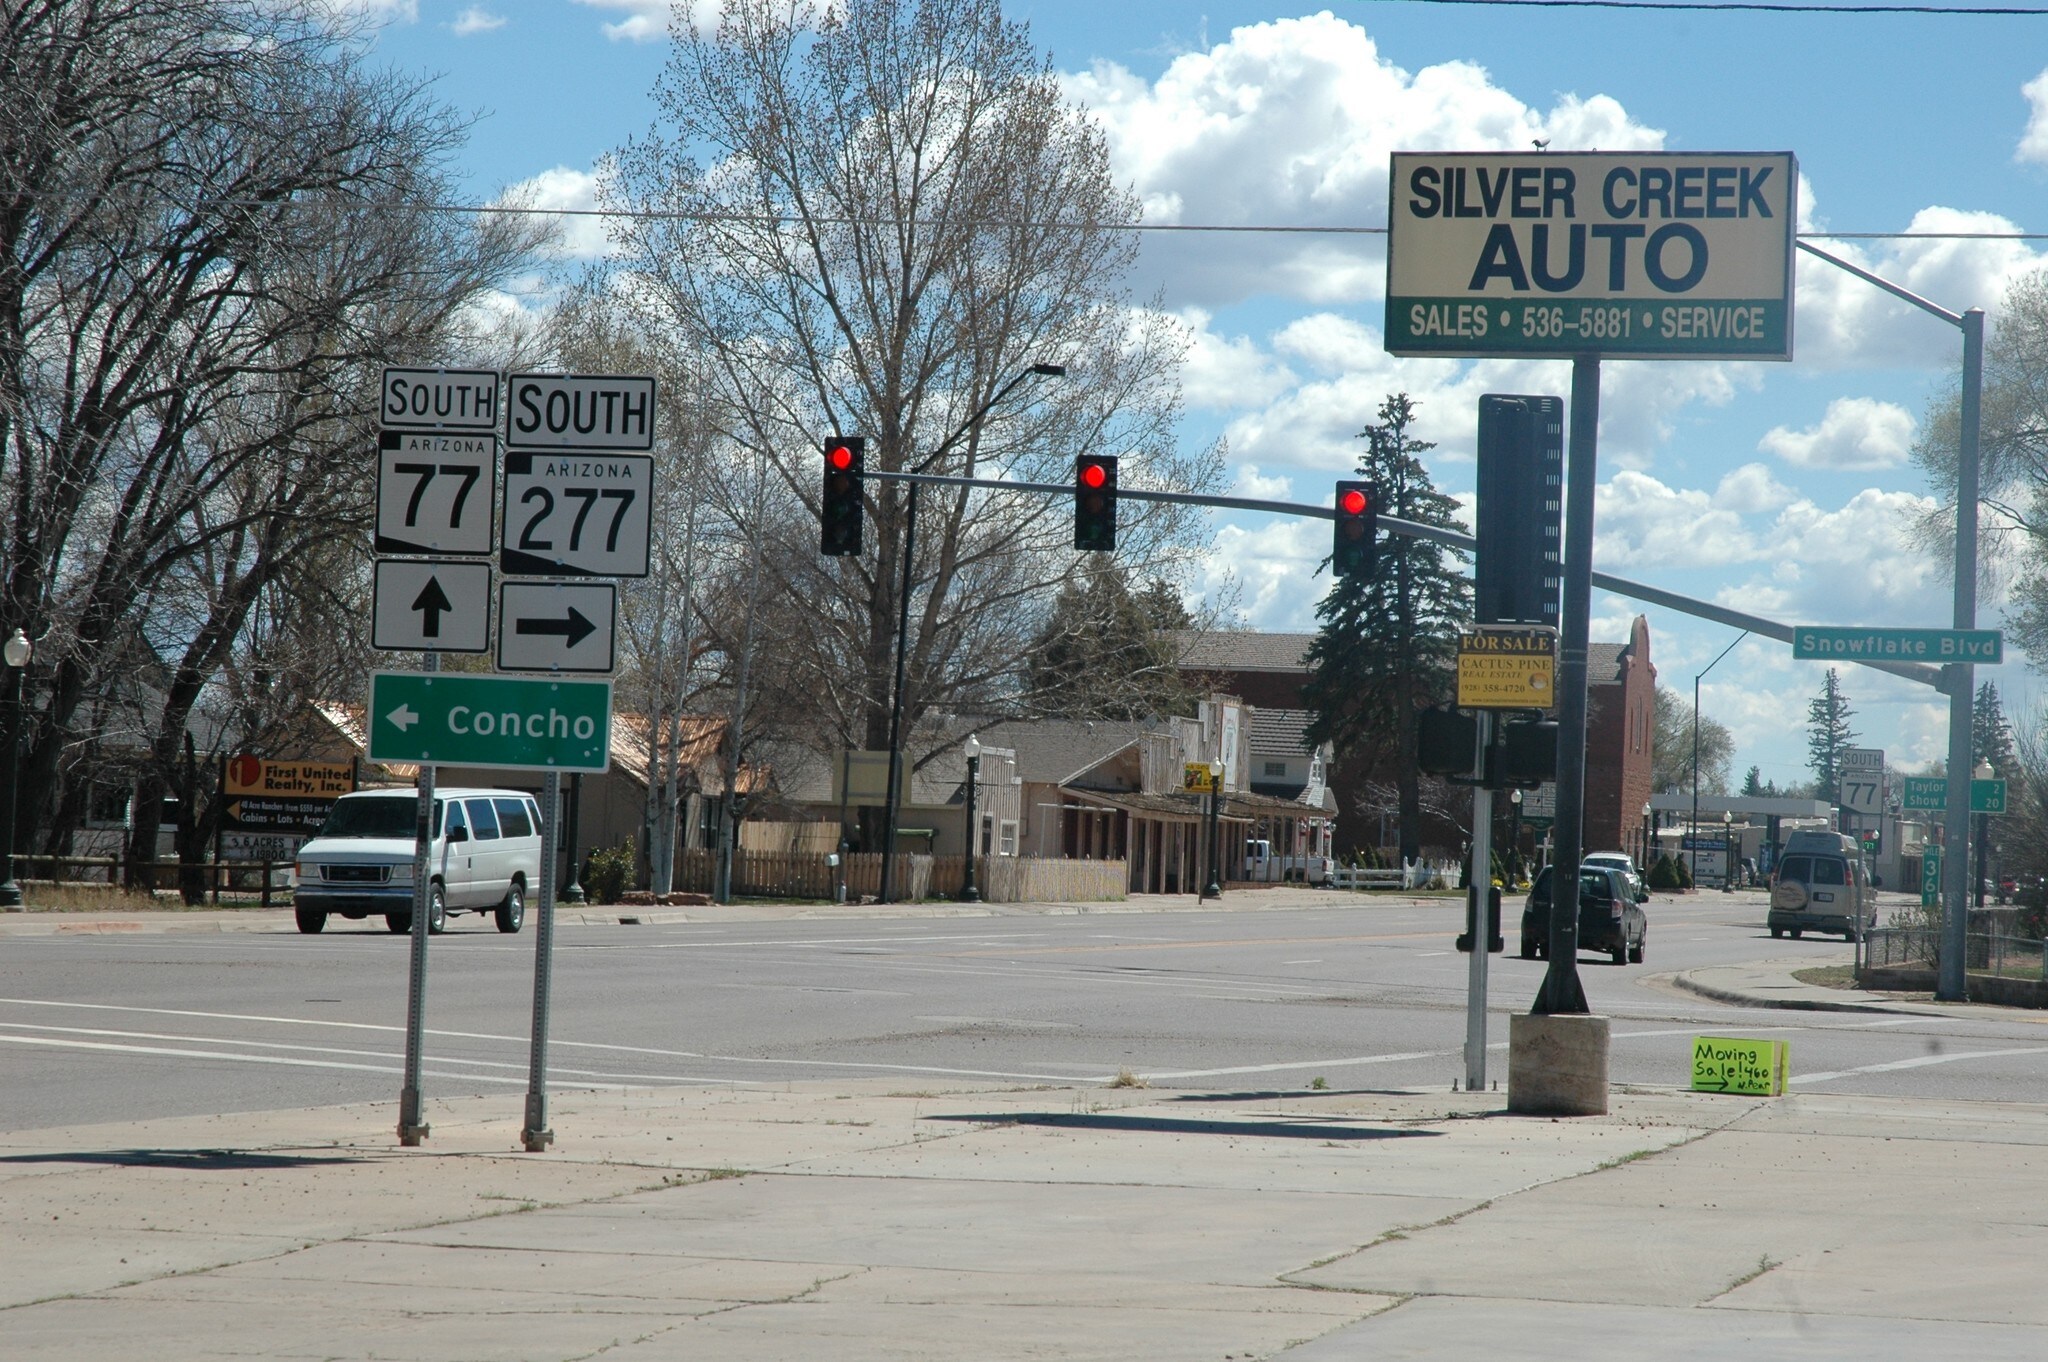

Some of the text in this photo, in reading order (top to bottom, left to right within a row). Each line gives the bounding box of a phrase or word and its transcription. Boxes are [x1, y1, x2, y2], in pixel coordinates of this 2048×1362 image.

[1409, 165, 1774, 219] SILVER CREEK
[1468, 222, 1709, 293] AUTO
[1410, 304, 1764, 338] SALES 536-5881 SERVICE
[387, 378, 493, 418] SOUTH
[515, 383, 647, 435] SOUTH
[409, 439, 485, 454] ARIZONA
[545, 462, 633, 478] ARIZONA
[394, 463, 481, 528] 77
[518, 485, 636, 552] 277
[1463, 636, 1549, 651] FOR SALE
[1802, 635, 1994, 656] Snowflake Blvd
[1461, 658, 1550, 670] CACTUS PINE
[1462, 670, 1522, 679] REAL ESTATE
[448, 705, 595, 739] Concho
[1844, 753, 1880, 766] SOUTH
[265, 766, 351, 780] First United
[265, 778, 347, 793] Realty, Inc.
[1846, 782, 1877, 805] 77
[1910, 781, 2000, 794] Taylor 2
[1910, 795, 1939, 806] Show
[1986, 798, 2000, 809] 20
[240, 812, 268, 823] Cabins
[277, 813, 294, 824] Lots
[253, 837, 284, 847] ACRES
[1695, 1044, 1757, 1064] Moving
